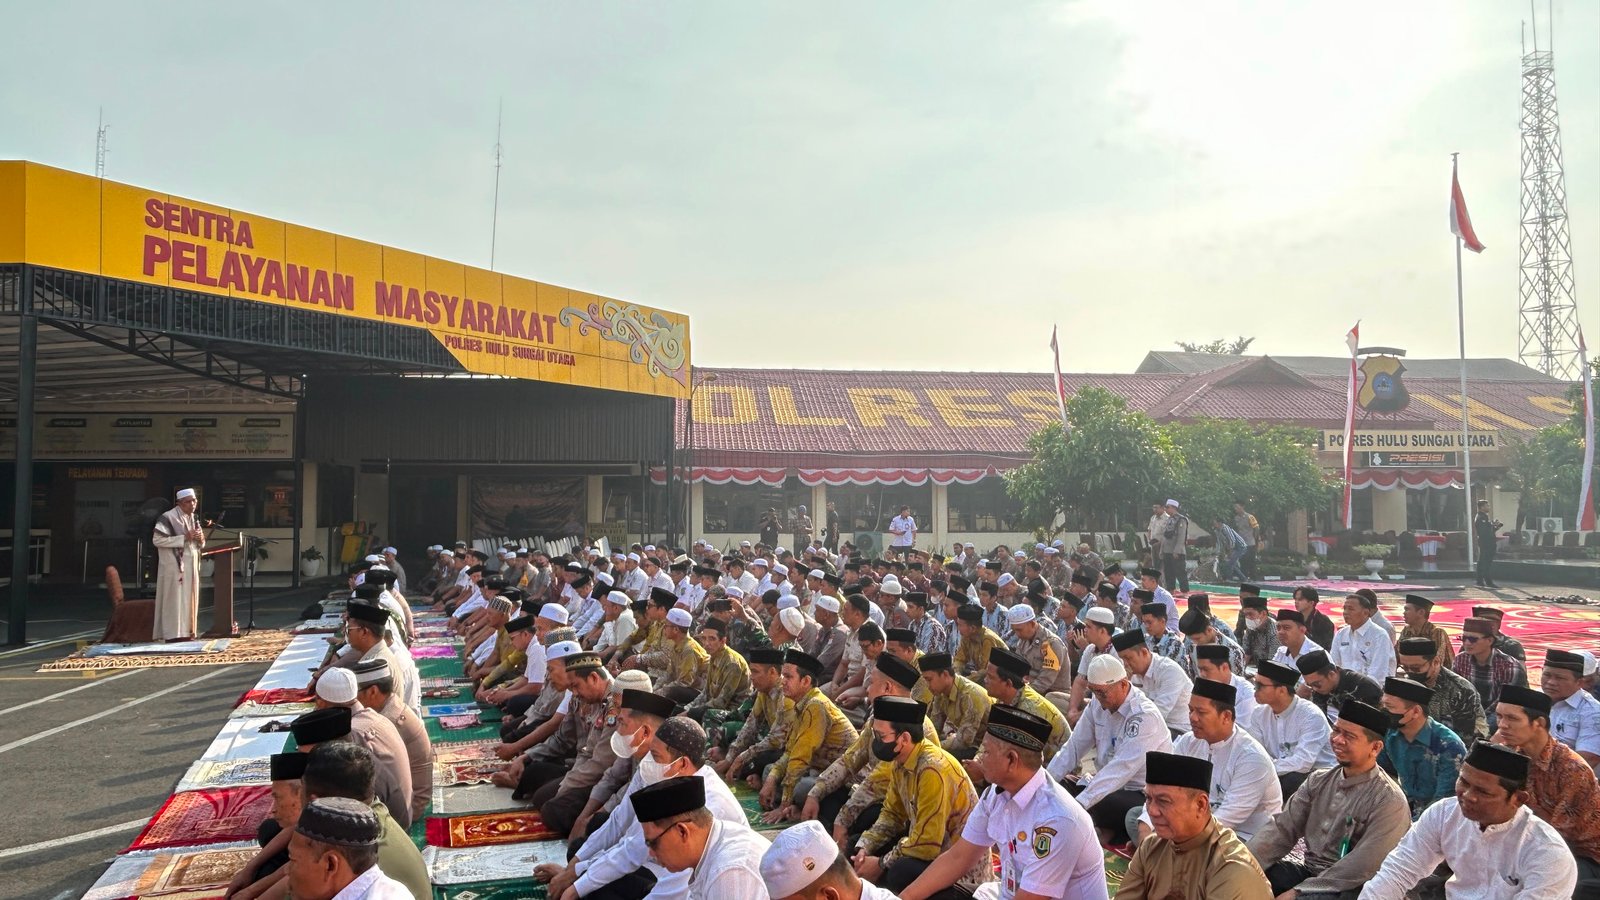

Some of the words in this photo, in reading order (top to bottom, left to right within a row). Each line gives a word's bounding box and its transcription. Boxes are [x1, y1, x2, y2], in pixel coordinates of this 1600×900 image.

[145, 198, 254, 249] SENTRA
[143, 235, 355, 310] PELAYANAN
[375, 281, 557, 345] MASYARAKAT
[445, 335, 482, 352] POLRES
[486, 341, 509, 356] HULU
[513, 345, 544, 361] SUNGAI
[547, 351, 575, 366] UTARA
[1329, 434, 1374, 447] PORES
[1377, 434, 1408, 447] HULU
[1411, 434, 1454, 447] SUNGAI
[1457, 434, 1495, 447] UTARA
[1389, 453, 1445, 462] PRESISI
[68, 467, 112, 479] PELAYANAN
[113, 467, 148, 479] TERPADU
